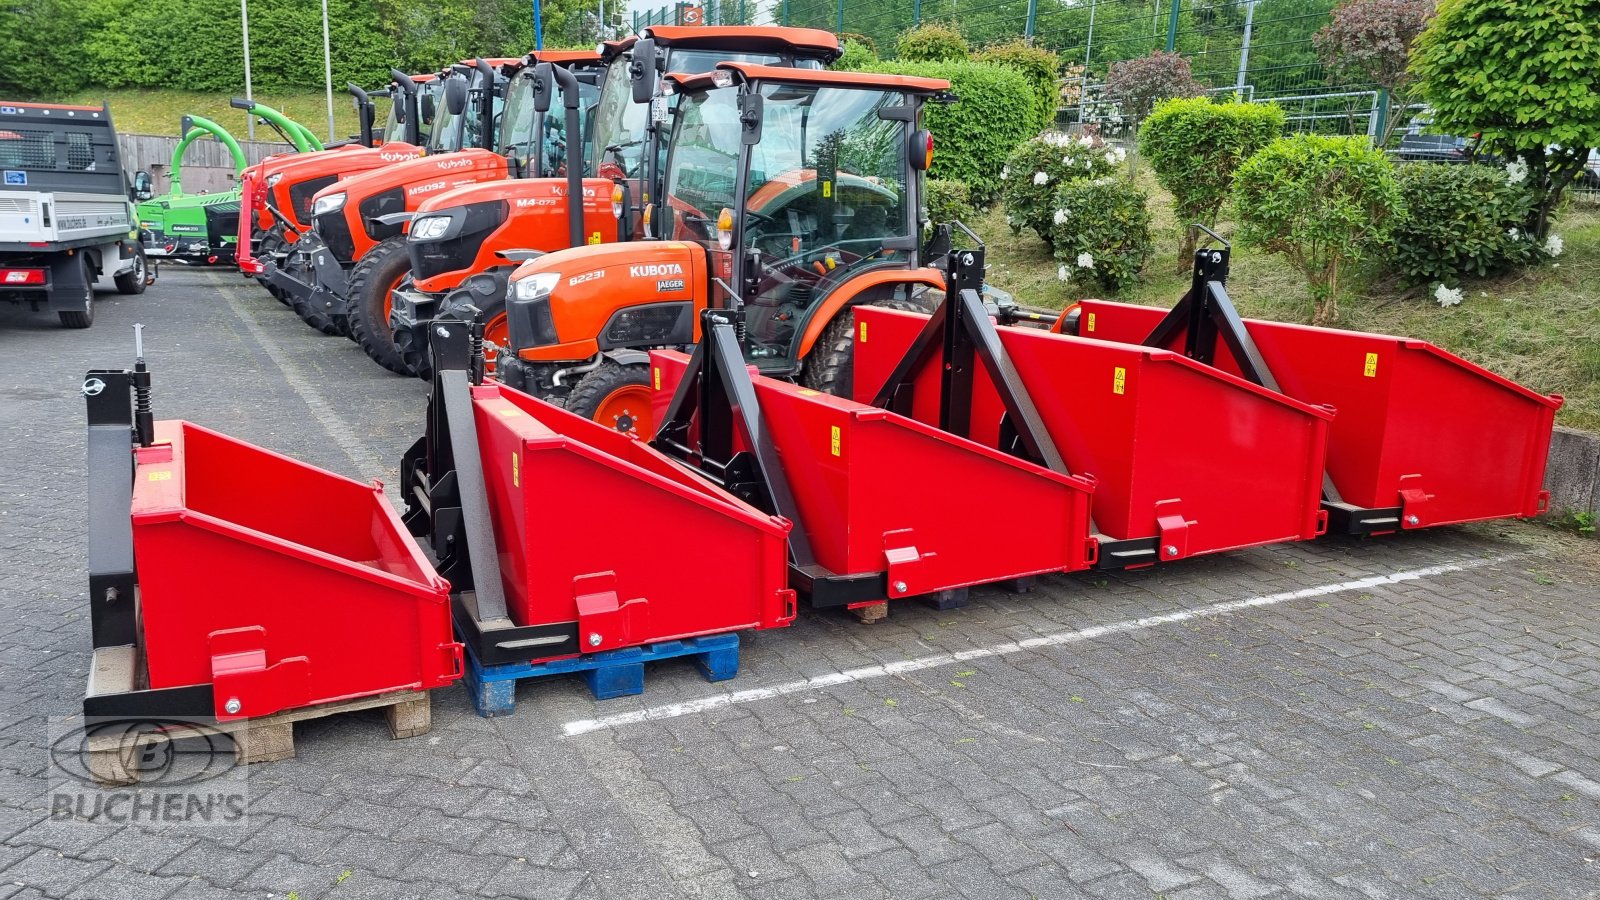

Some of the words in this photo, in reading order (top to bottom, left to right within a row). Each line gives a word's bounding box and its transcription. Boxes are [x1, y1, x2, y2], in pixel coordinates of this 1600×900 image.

[381, 152, 420, 162] Kubota
[437, 158, 473, 170] Kubota
[408, 181, 446, 196] M5092
[552, 186, 595, 197] Kuta
[516, 198, 556, 208] M4-073
[630, 263, 683, 278] KUBOTA
[569, 270, 605, 287] B2231
[656, 280, 684, 292] JAEGER
